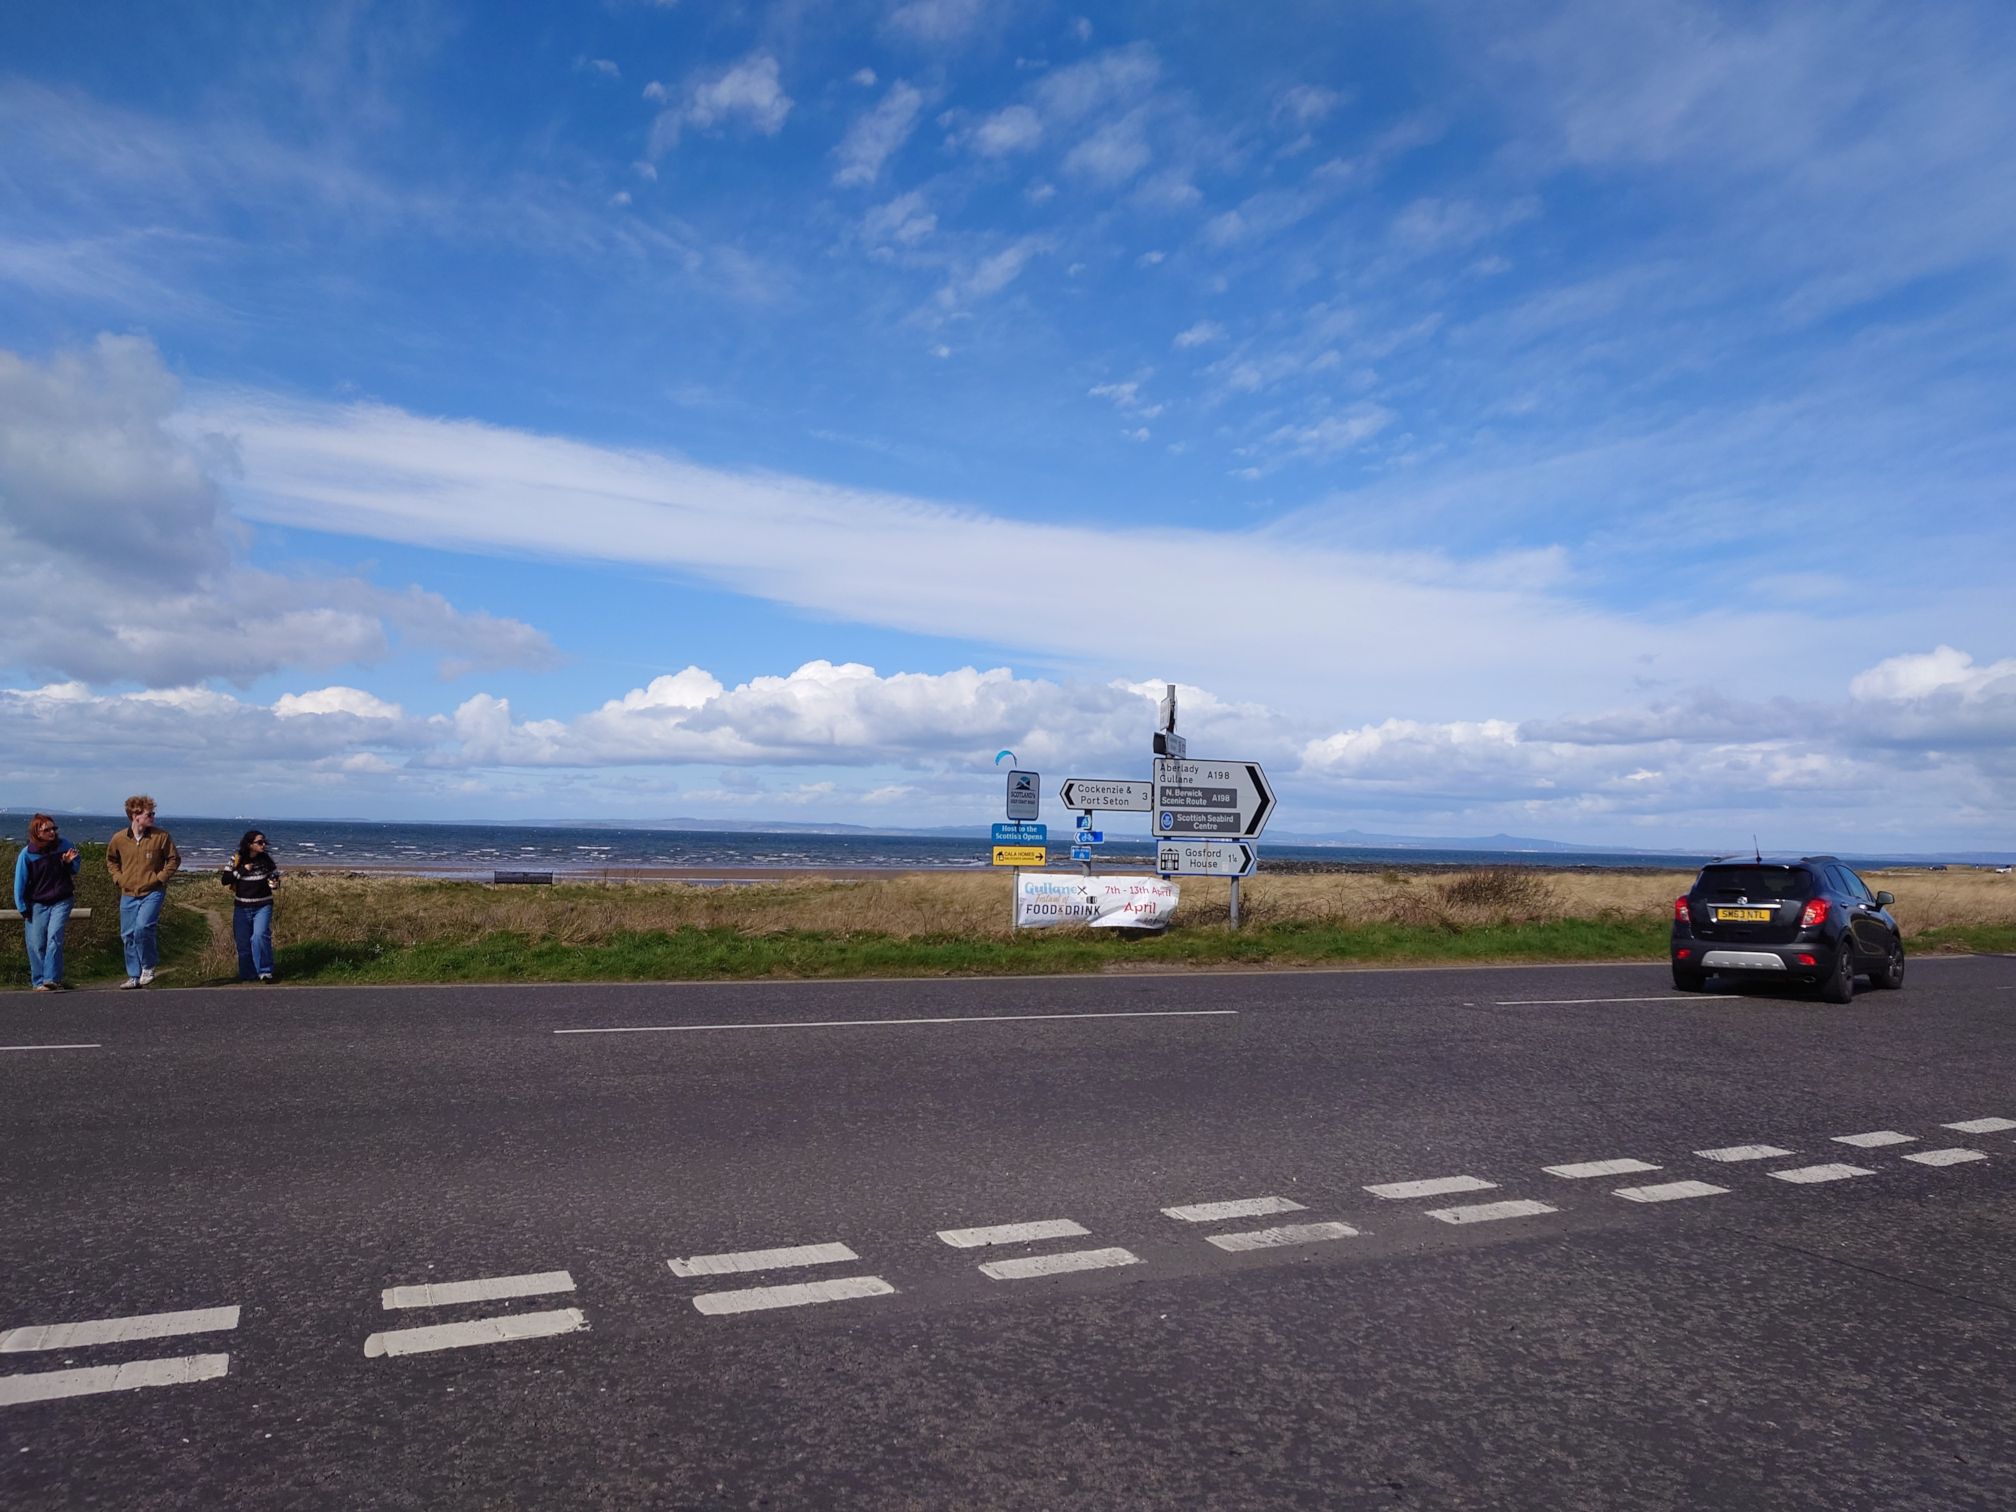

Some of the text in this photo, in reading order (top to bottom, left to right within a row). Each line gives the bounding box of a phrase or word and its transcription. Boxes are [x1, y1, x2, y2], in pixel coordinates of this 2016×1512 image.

[1159, 763, 1199, 774] Aberlady
[1159, 775, 1193, 783] Gullane
[1207, 771, 1230, 780] A198
[1077, 784, 1132, 794] Cockenzie &
[1174, 789, 1203, 798] Berwick
[1080, 795, 1129, 806] Port Seton
[1142, 792, 1148, 801] 3
[1211, 794, 1230, 802] A198
[1186, 798, 1207, 806] Route
[1176, 814, 1234, 823] Scottish Seabird
[1193, 822, 1218, 830] Centre
[1022, 833, 1043, 841] Opens
[1185, 848, 1221, 858] Gosford
[1189, 859, 1218, 868] House
[1024, 881, 1077, 895] Gullane
[1105, 885, 1120, 895] 7th
[1129, 886, 1149, 895] 13th
[1152, 886, 1172, 897] April
[1026, 904, 1057, 915] FOOD
[1065, 905, 1101, 916] DRINK
[1123, 901, 1156, 914] April
